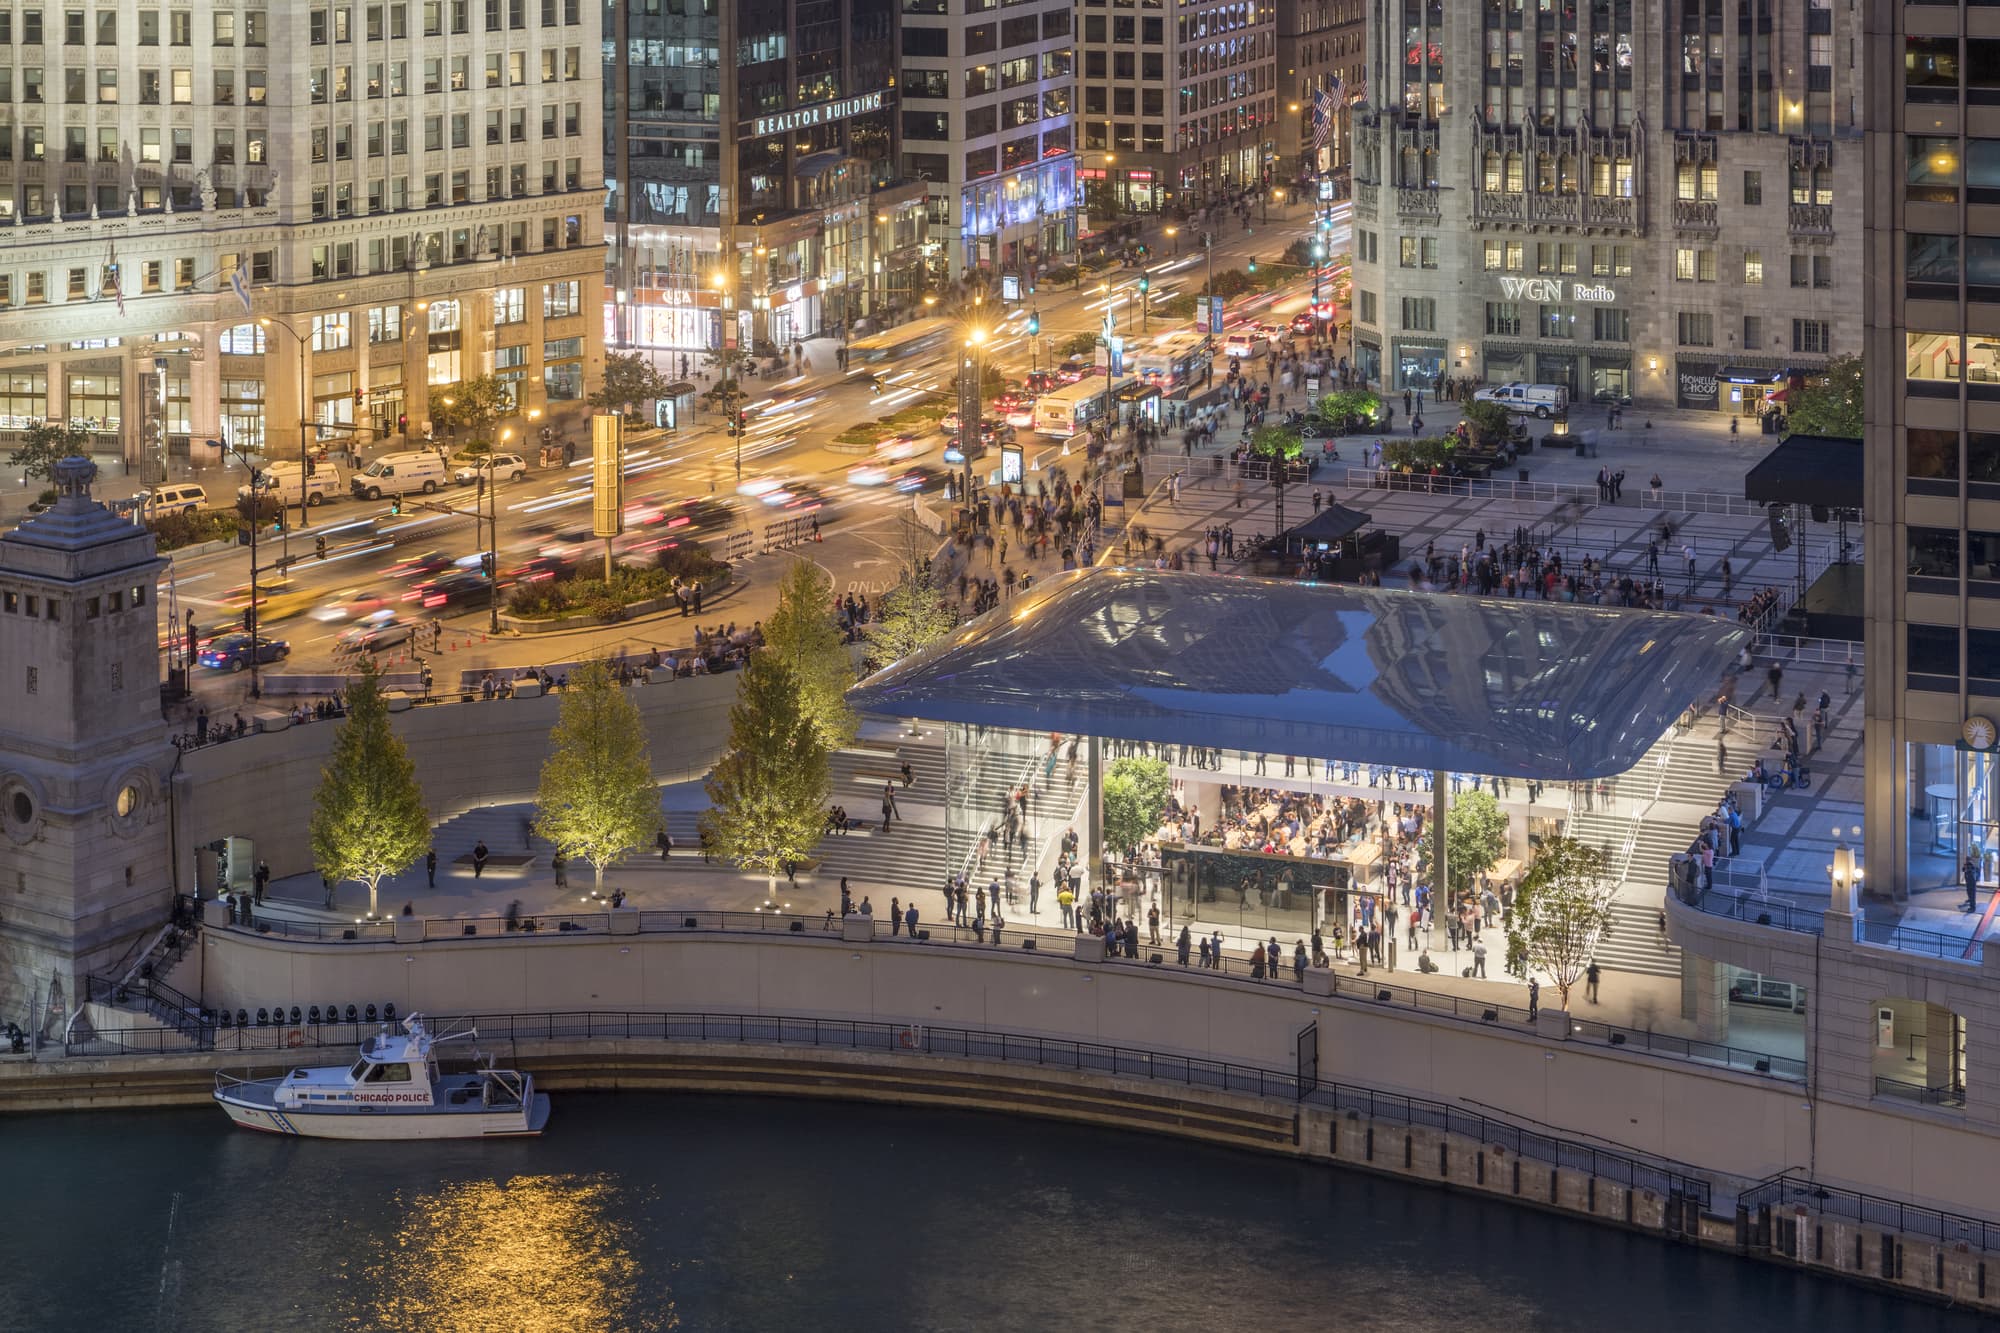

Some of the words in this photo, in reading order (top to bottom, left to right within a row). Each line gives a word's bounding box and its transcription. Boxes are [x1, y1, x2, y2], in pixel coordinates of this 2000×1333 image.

[758, 109, 819, 135] REALTOR
[826, 94, 880, 120] BUILDING
[1500, 277, 1563, 301] WGN
[1573, 283, 1615, 302] Radio
[1680, 373, 1717, 386] HOWELLS
[1690, 383, 1717, 394] HOOD
[847, 580, 890, 593] ONLY
[354, 1093, 394, 1102] CHICAGO
[395, 1093, 430, 1102] POLICE
